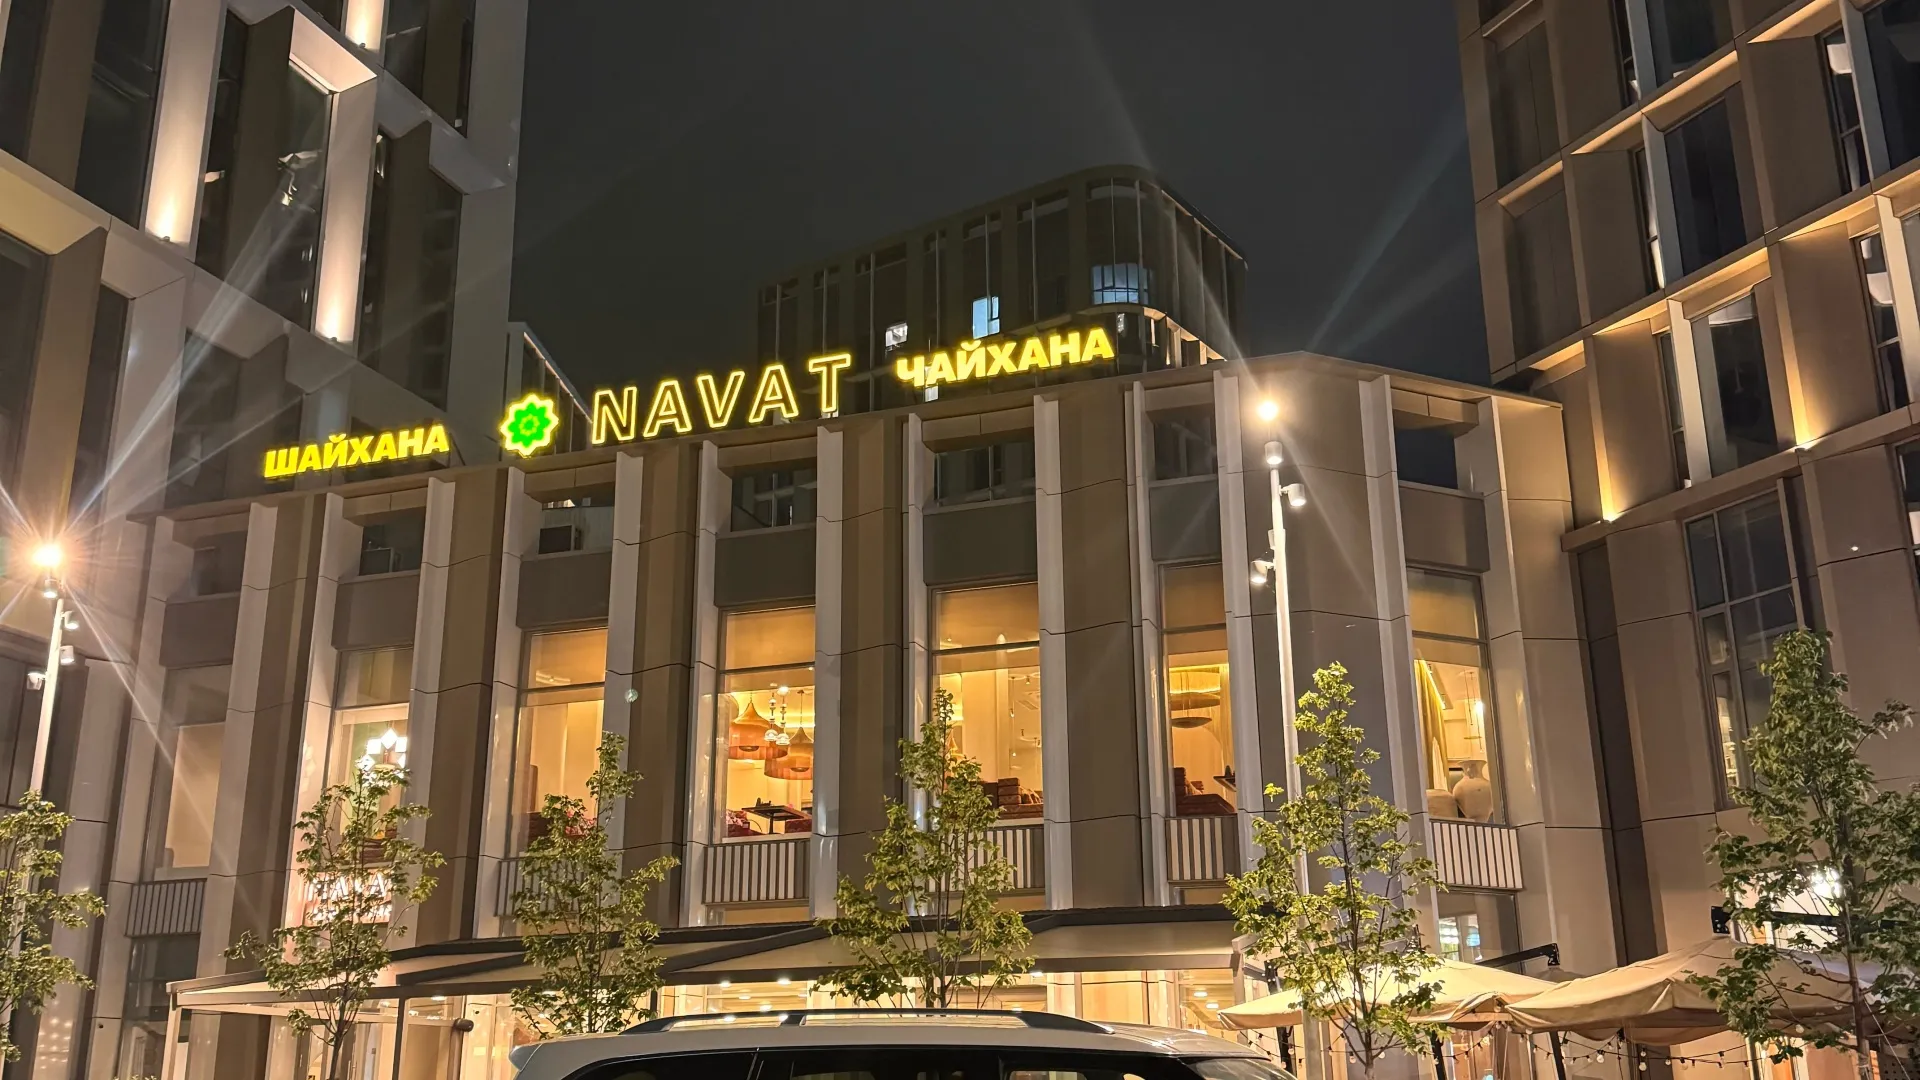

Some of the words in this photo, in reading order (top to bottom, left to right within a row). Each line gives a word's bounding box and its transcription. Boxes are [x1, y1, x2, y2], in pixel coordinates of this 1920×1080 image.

[896, 328, 1114, 387] ЧАЙХАНА
[591, 353, 851, 444] NAVAT
[264, 424, 450, 478] ШАЙХАНА
